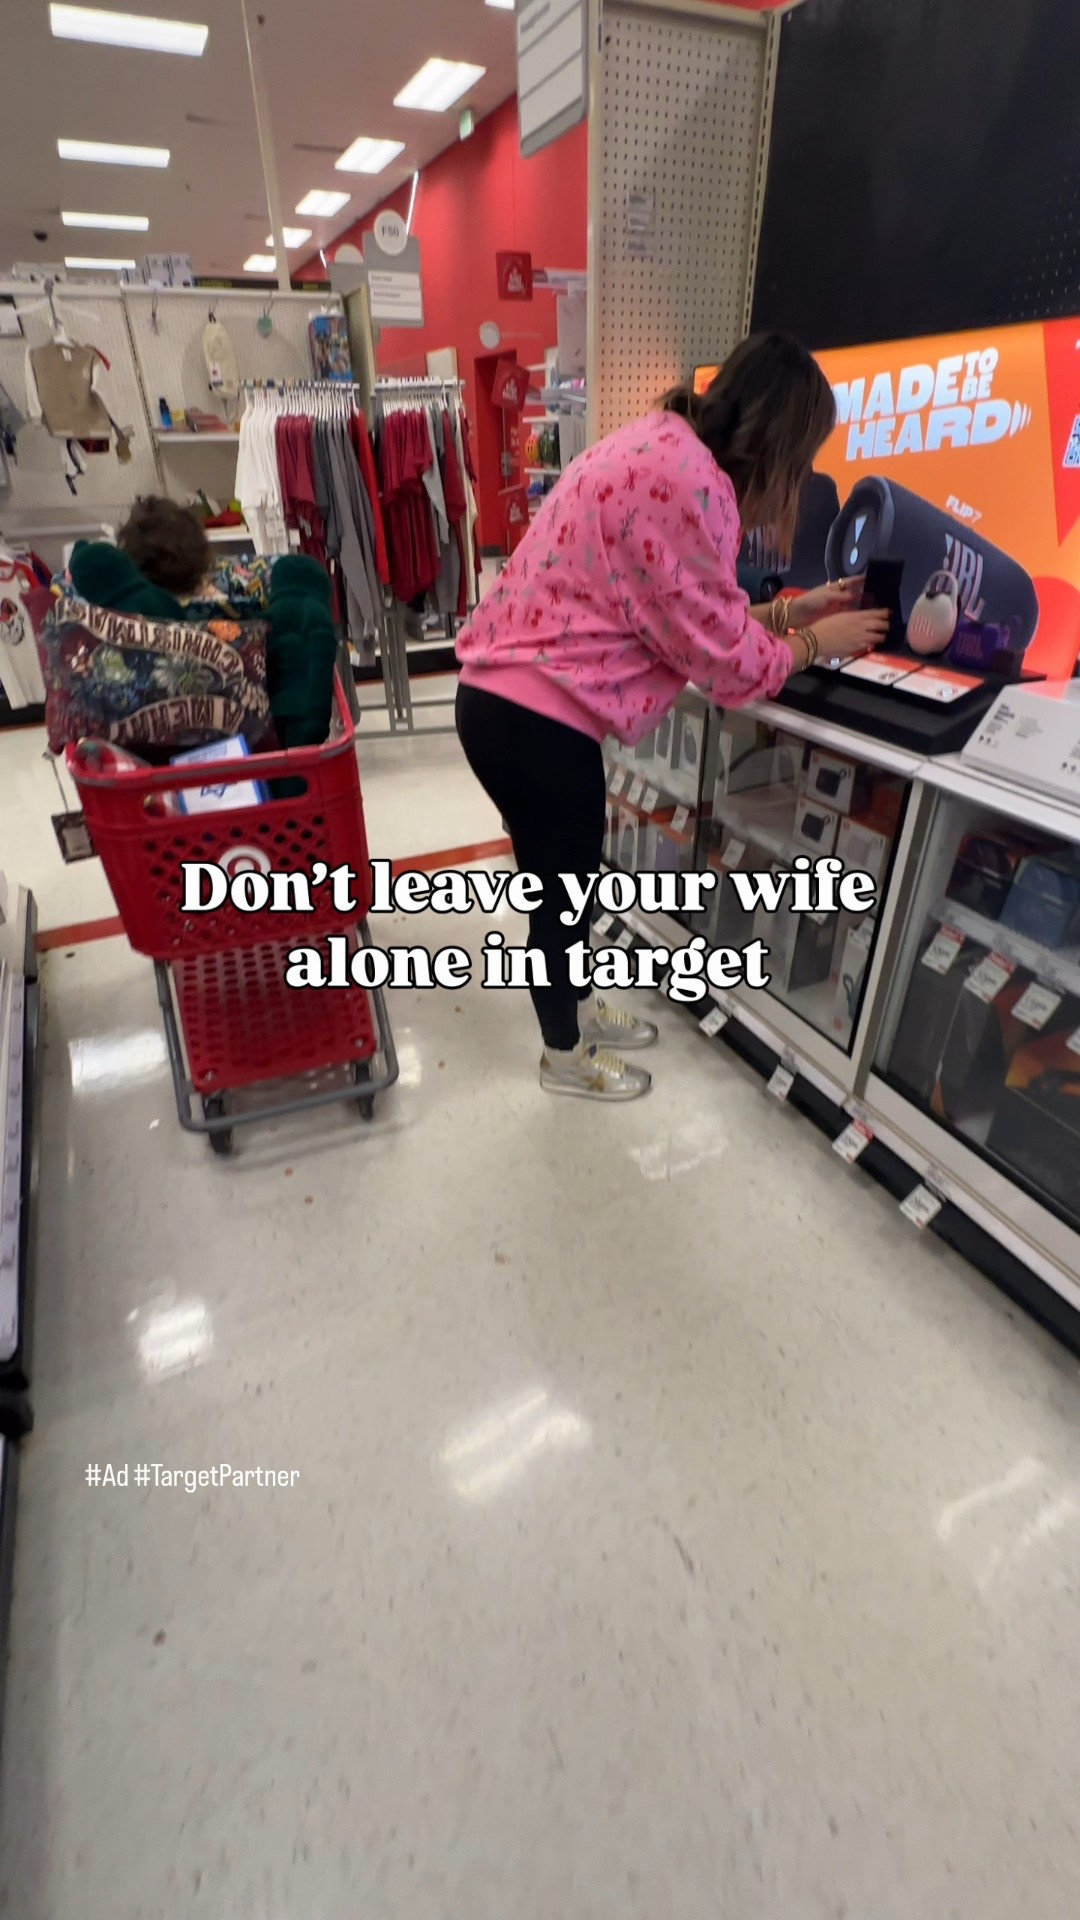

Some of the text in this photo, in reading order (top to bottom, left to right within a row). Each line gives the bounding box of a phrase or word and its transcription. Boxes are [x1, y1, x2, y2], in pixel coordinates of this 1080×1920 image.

[832, 347, 999, 425] MADE TO
[961, 373, 994, 402] BE
[846, 399, 1012, 461] HEARD
